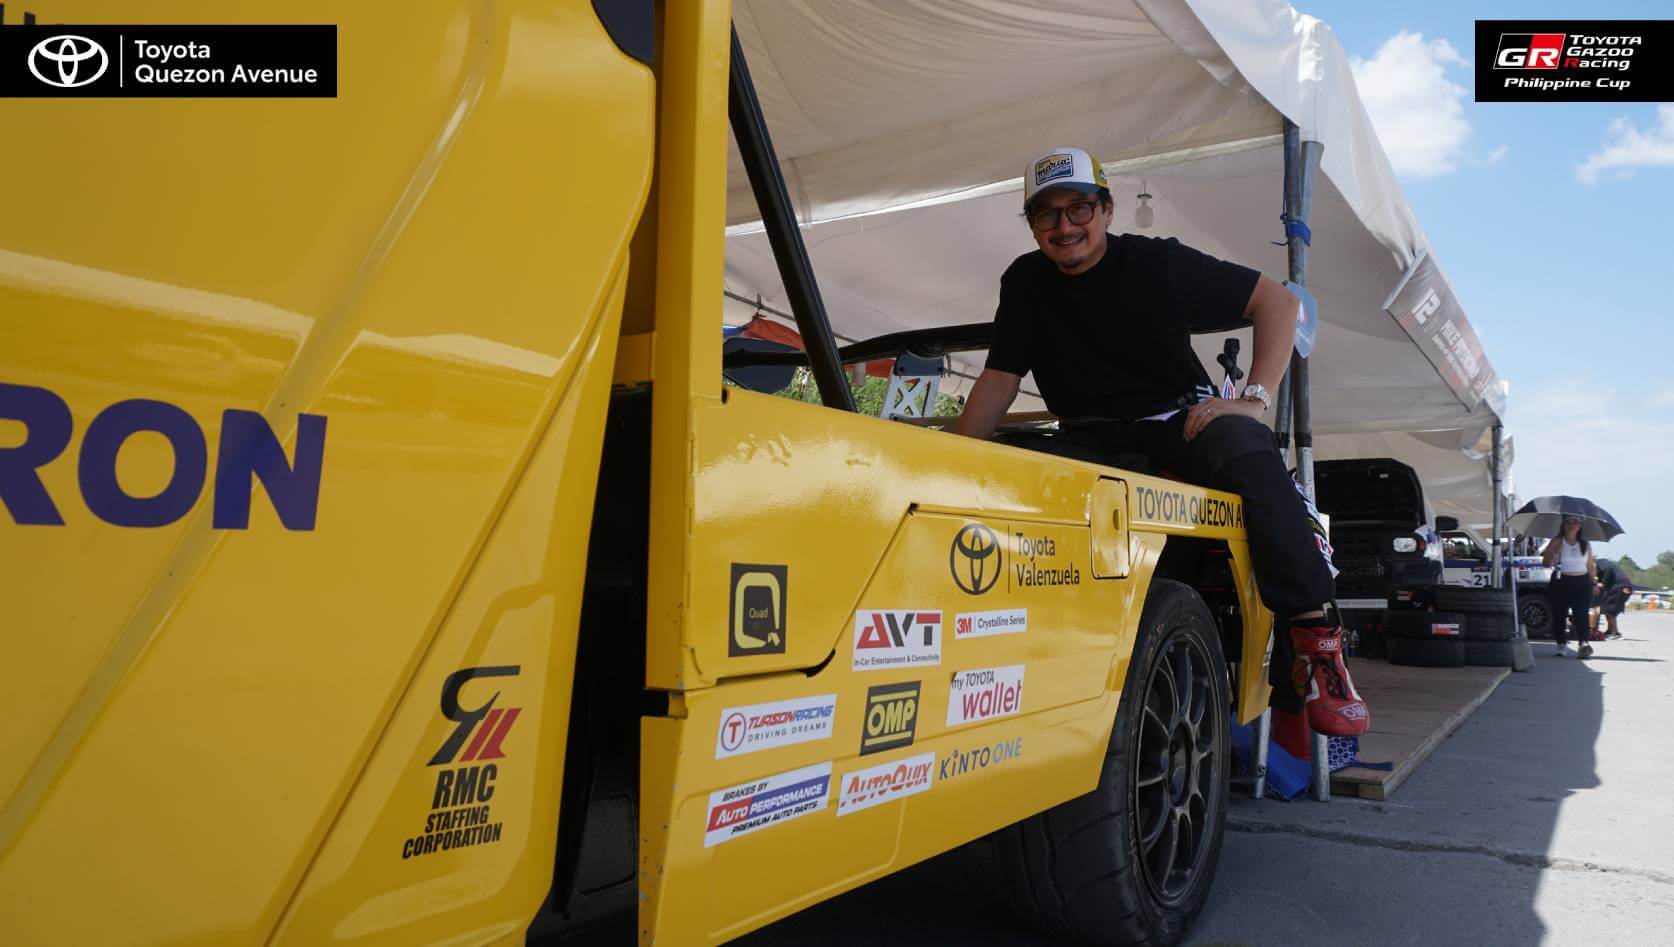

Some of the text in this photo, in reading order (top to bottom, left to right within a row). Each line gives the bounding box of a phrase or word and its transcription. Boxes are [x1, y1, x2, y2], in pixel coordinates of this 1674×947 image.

[1136, 487, 1187, 523] TOYOTA
[1190, 496, 1234, 528] QUEZON
[1016, 532, 1056, 561] Toyota
[1016, 563, 1081, 587] Valenzuela
[1474, 574, 1490, 586] 21
[749, 608, 768, 618] Quad
[957, 615, 1025, 634] 3M Crystalline Series
[856, 613, 941, 649] AVT
[965, 670, 995, 688] TOYOTA
[963, 679, 1022, 720] wallet
[748, 721, 827, 742] DRIVING DREAMS
[867, 699, 916, 737] OMP
[993, 737, 1022, 764] ONE
[432, 764, 498, 810] RMC
[723, 781, 769, 802] BRAKES BY
[715, 783, 823, 826] AUTO PERFORMANCE
[731, 801, 818, 834] PREMIUM AUTO PARTS
[425, 805, 490, 833] STAFFING
[402, 823, 502, 860] CORPORATION
